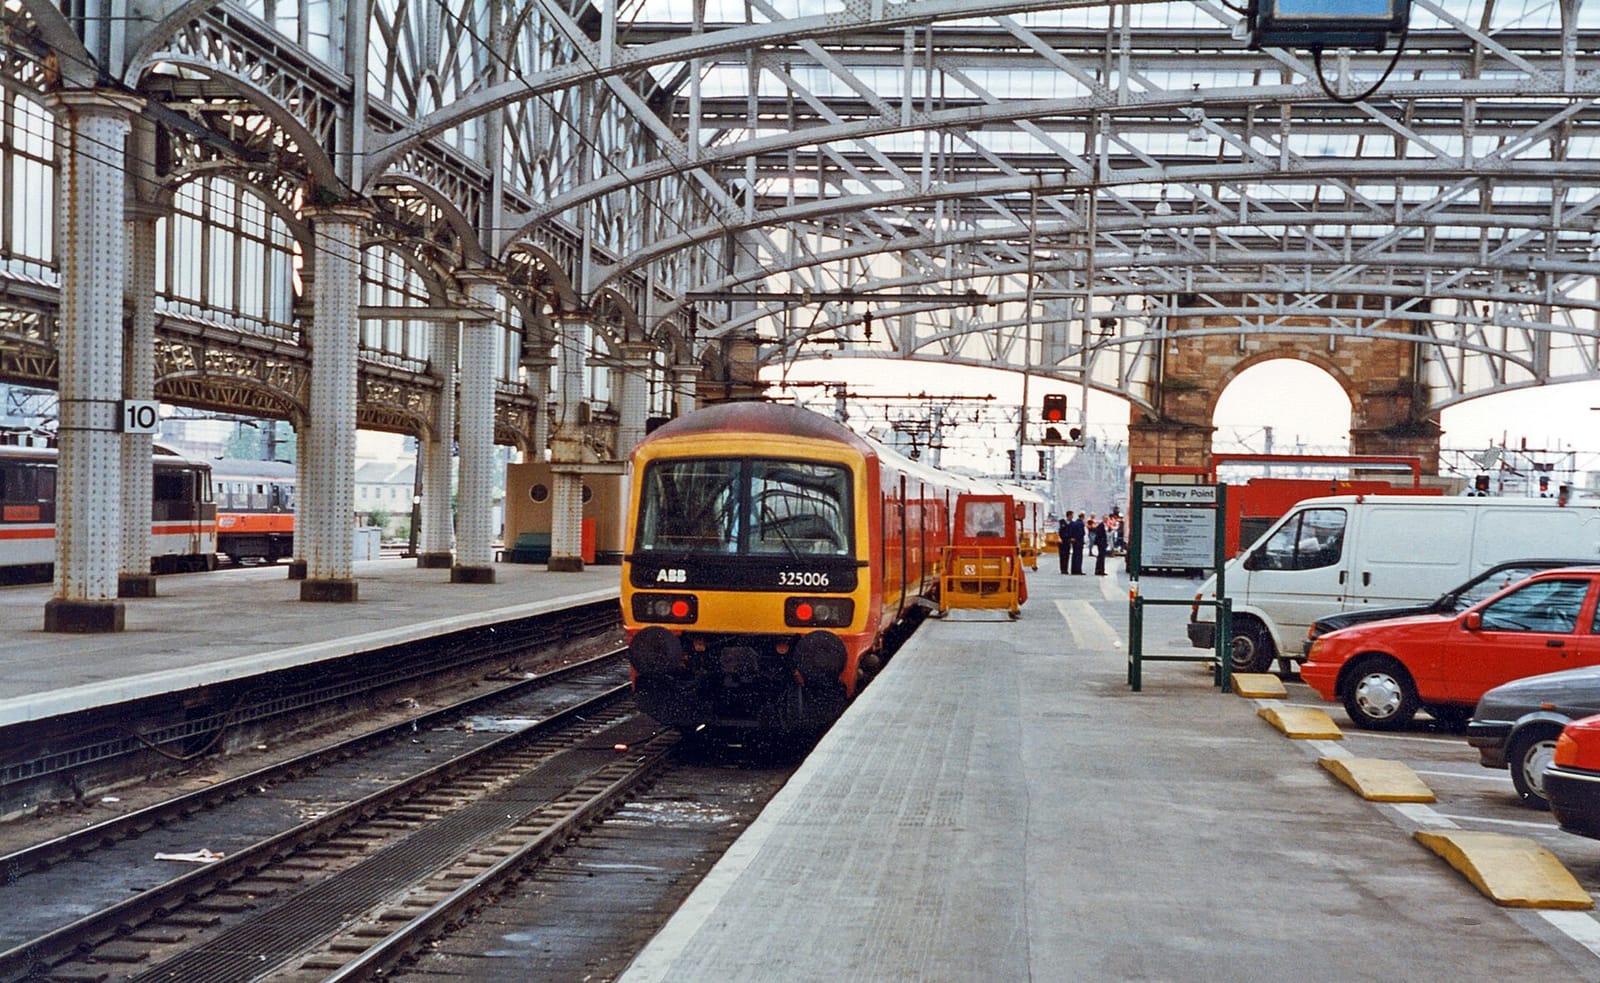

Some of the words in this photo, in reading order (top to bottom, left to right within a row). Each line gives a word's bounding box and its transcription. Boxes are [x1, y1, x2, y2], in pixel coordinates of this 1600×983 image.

[127, 405, 156, 429] 10
[1158, 488, 1187, 499] Trolley
[1190, 488, 1215, 498] Point
[656, 569, 687, 583] ABB
[778, 572, 829, 586] 325006
